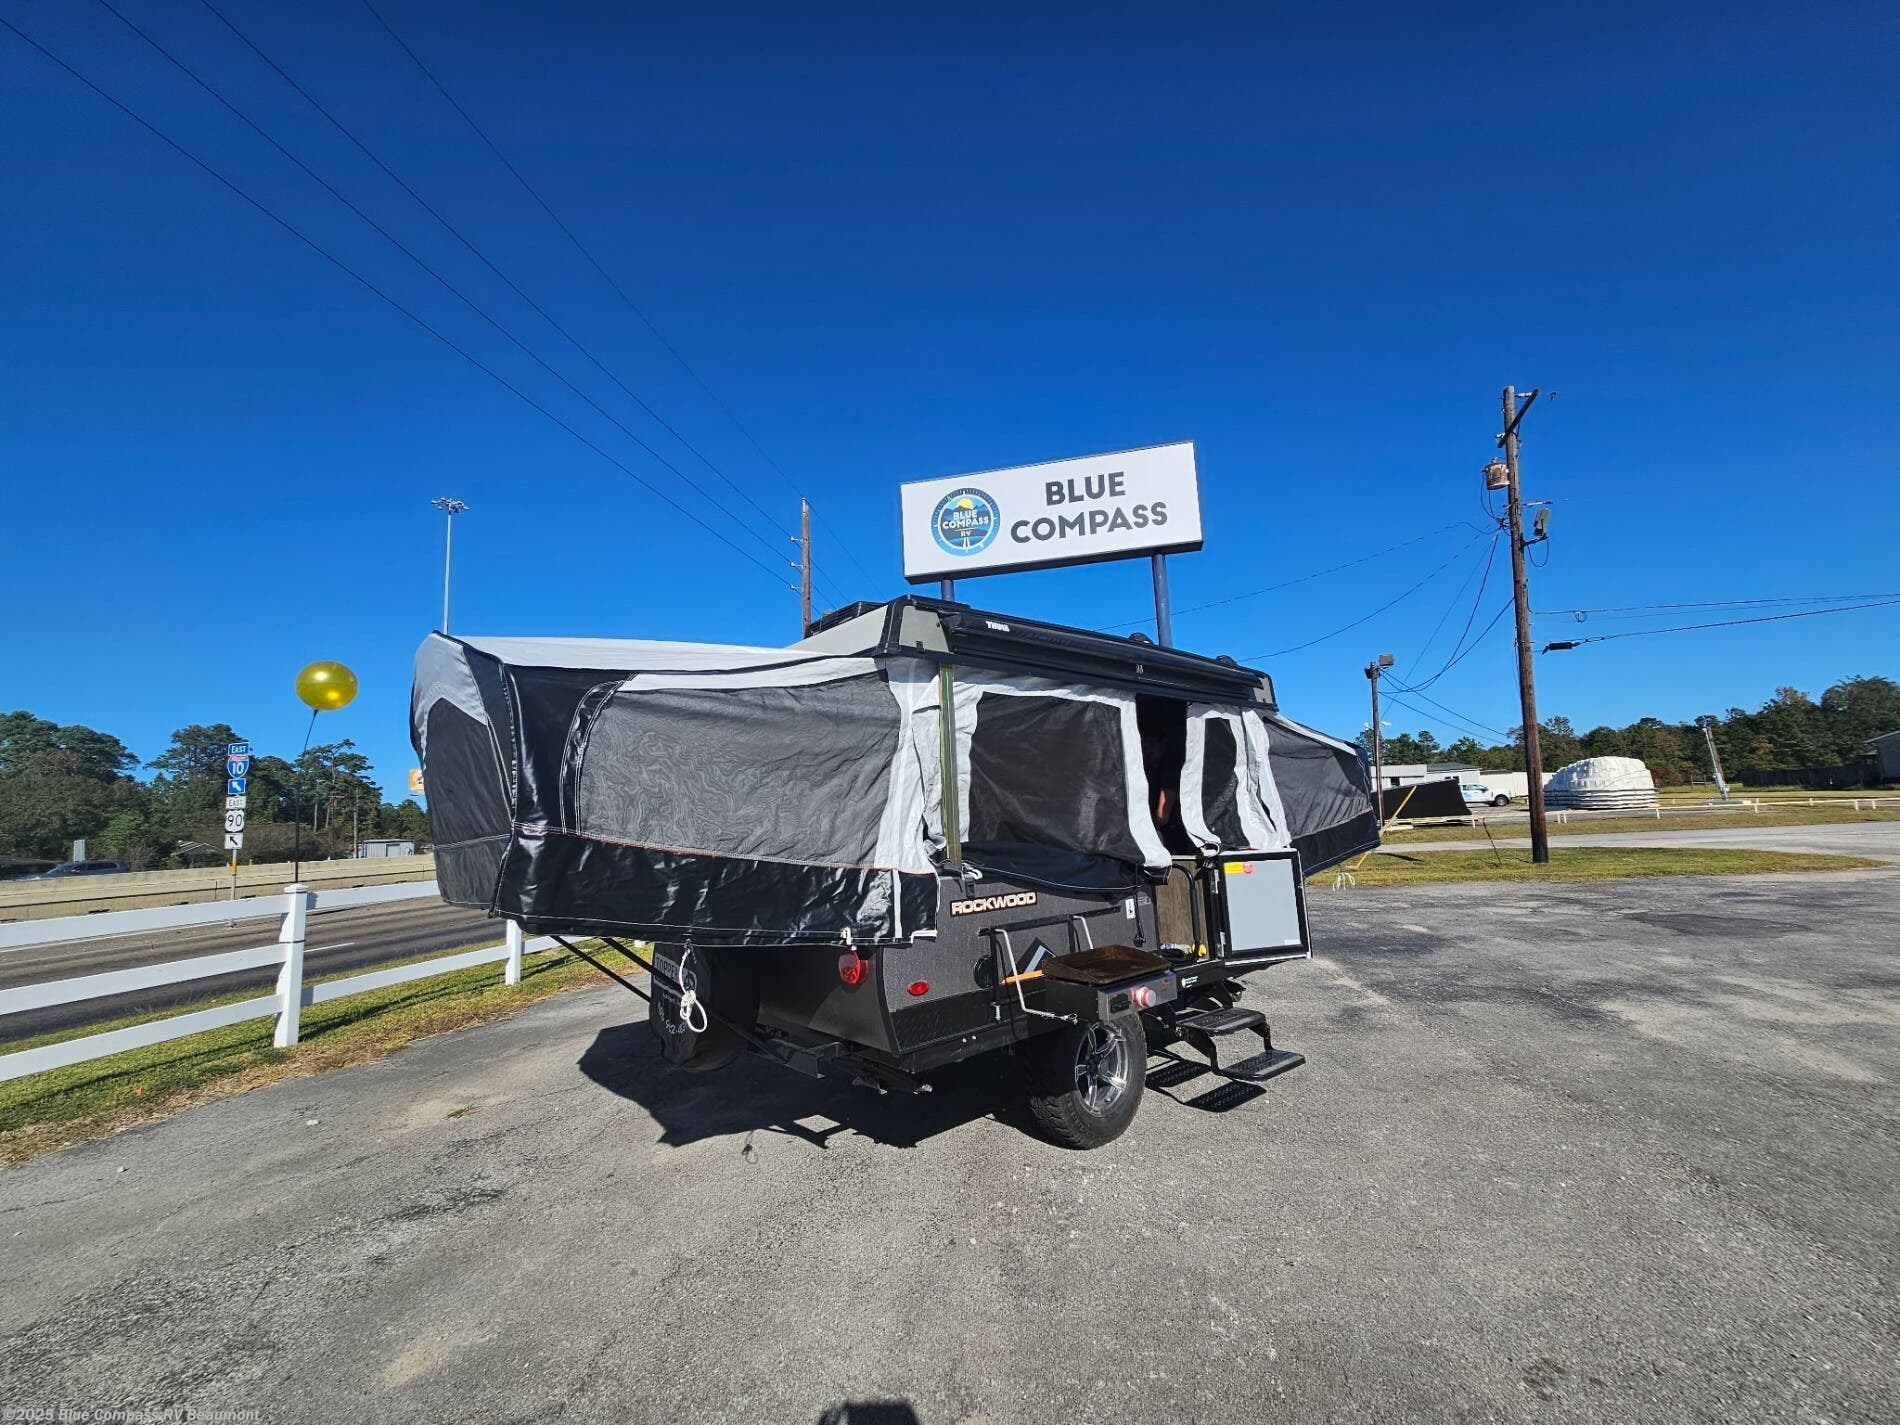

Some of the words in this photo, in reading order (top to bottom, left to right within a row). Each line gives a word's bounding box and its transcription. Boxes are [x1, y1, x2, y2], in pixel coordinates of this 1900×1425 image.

[1045, 471, 1125, 506] BLUE
[953, 509, 978, 520] BLUE
[942, 516, 989, 529] COMPASS
[1010, 501, 1168, 544] COMPASS
[231, 745, 247, 754] EAST
[232, 762, 245, 775] 10
[228, 799, 243, 807] EAST
[228, 814, 242, 827] 90
[951, 892, 1036, 915] ROCKWOOD
